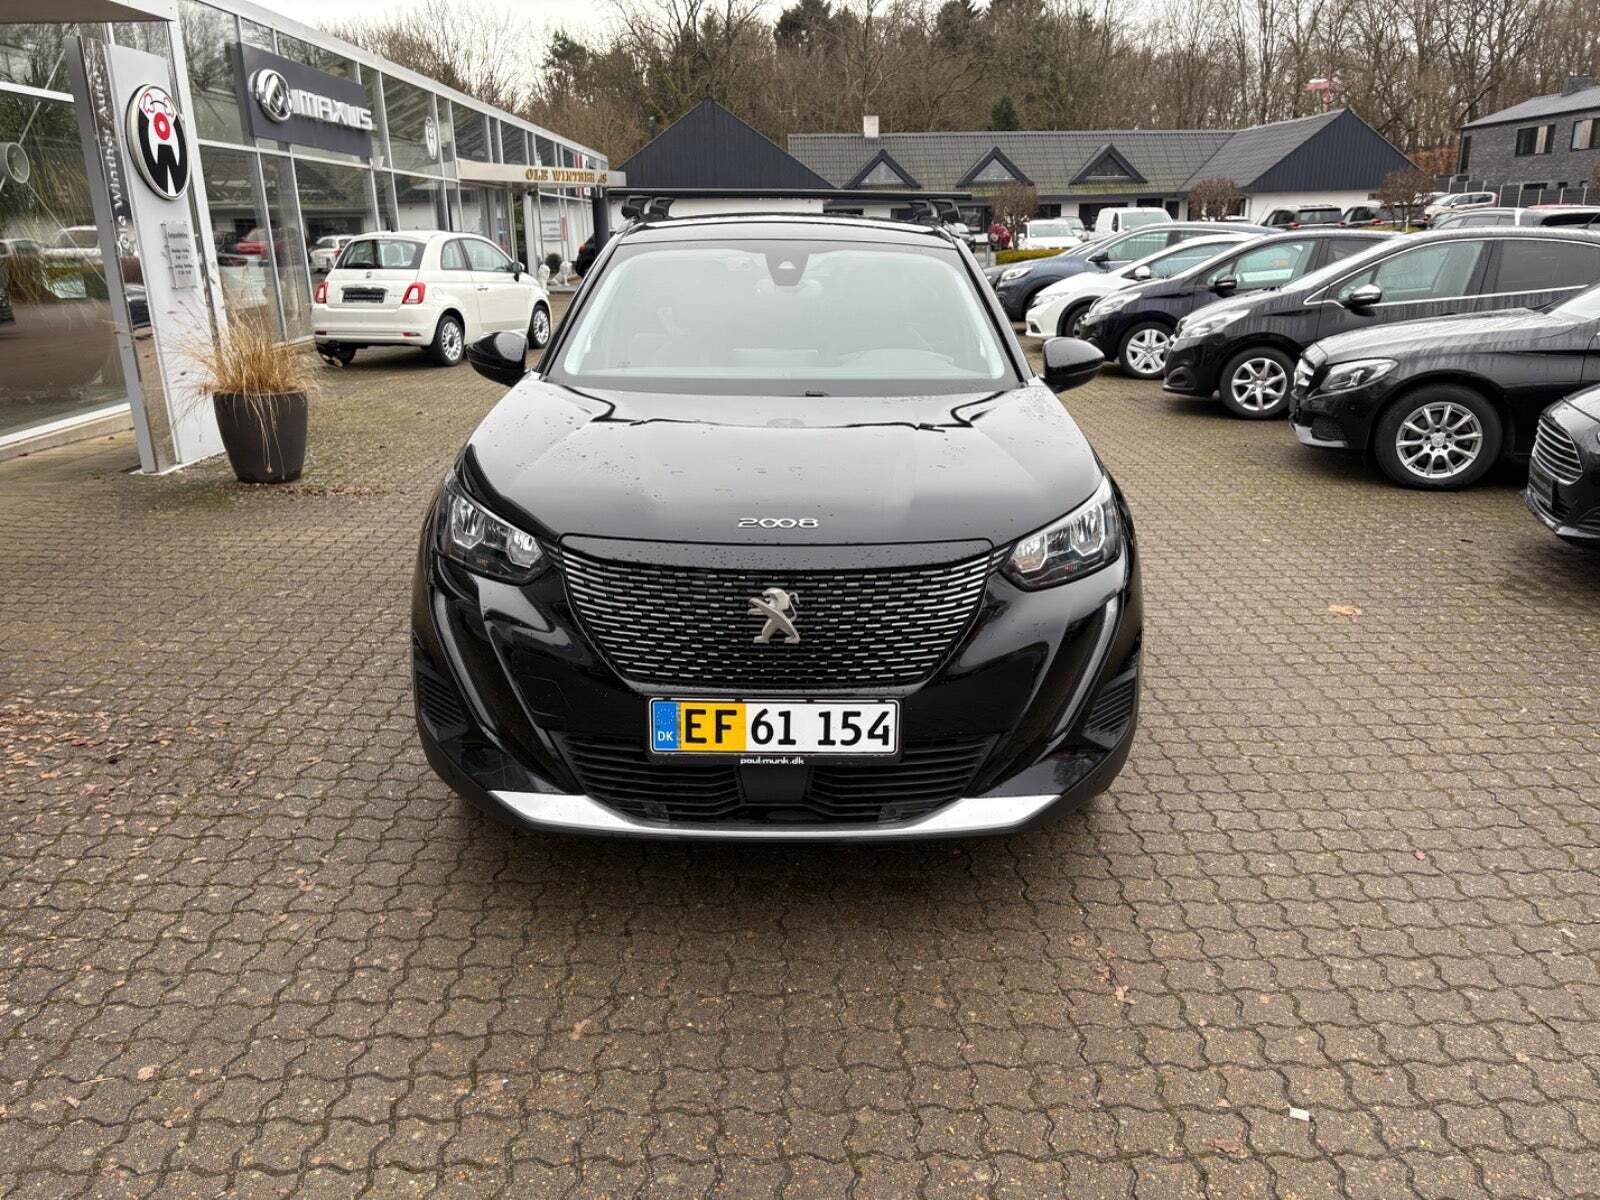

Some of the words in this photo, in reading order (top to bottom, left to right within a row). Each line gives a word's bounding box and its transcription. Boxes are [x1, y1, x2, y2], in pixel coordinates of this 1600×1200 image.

[525, 168, 549, 181] OLE
[552, 170, 595, 183] WINTHER
[737, 517, 819, 529] 2008
[684, 708, 738, 744] EF
[751, 708, 797, 745] 61
[817, 710, 890, 746] 154
[657, 731, 674, 742] DK
